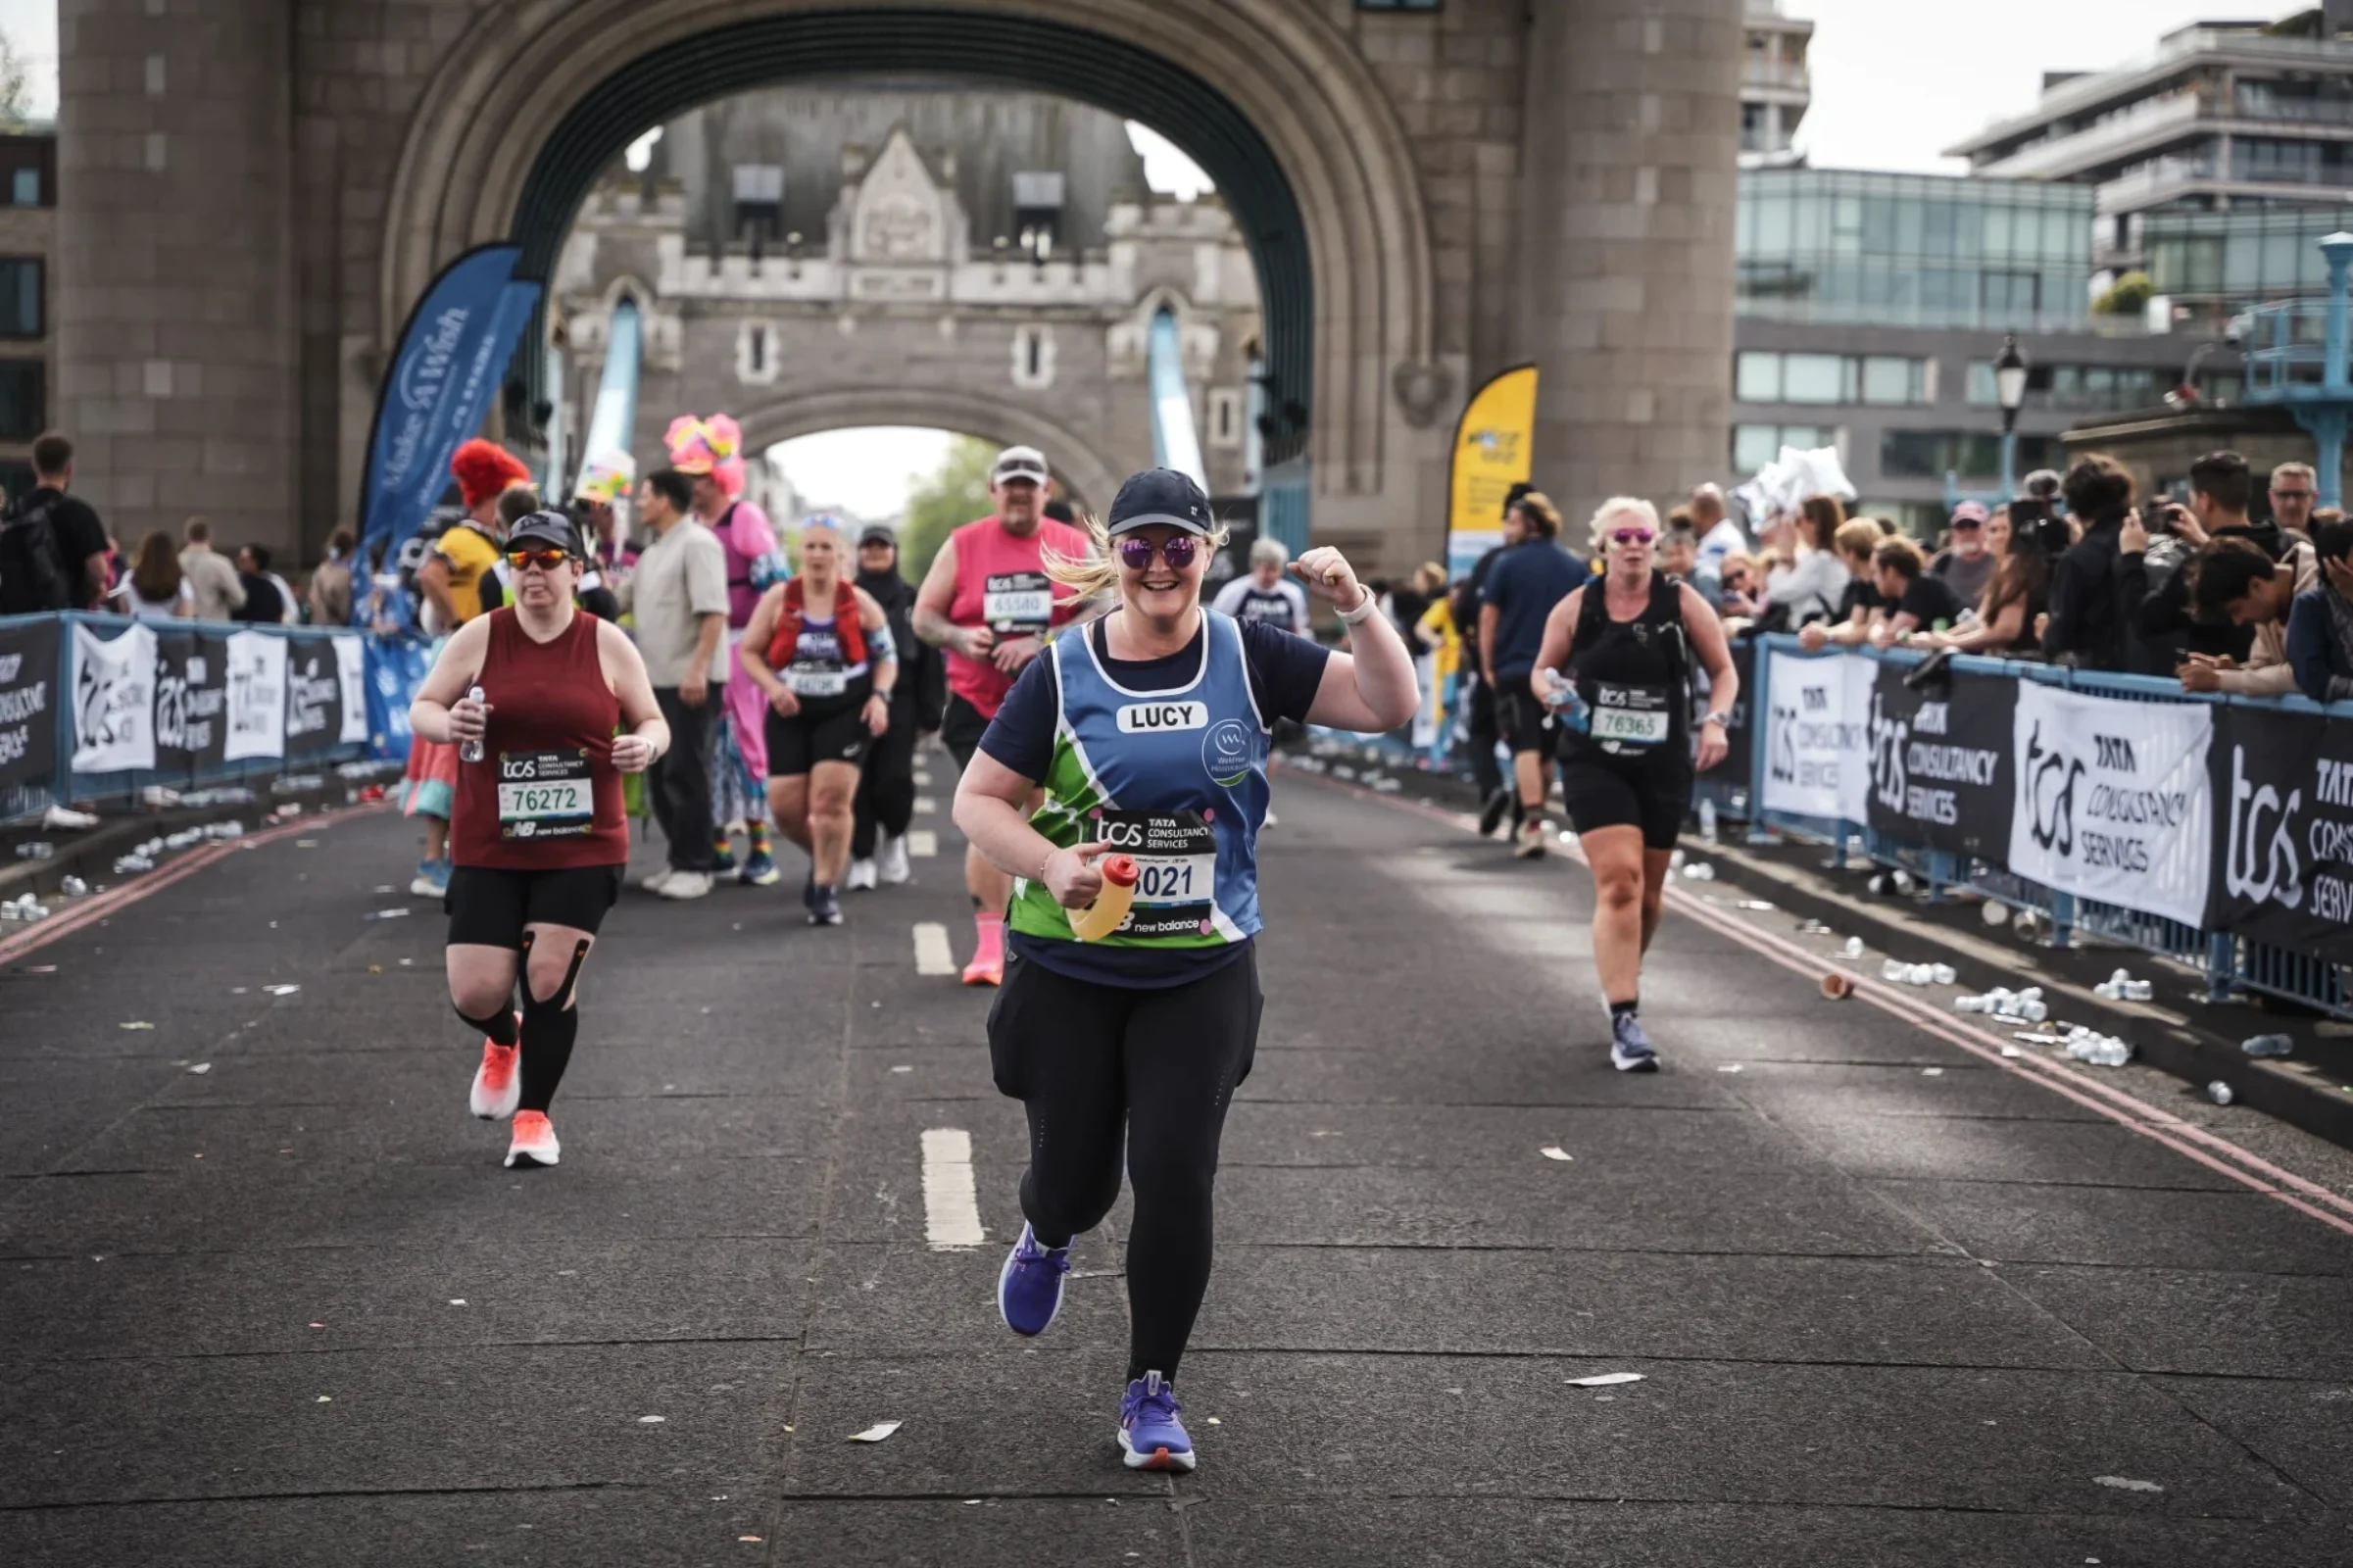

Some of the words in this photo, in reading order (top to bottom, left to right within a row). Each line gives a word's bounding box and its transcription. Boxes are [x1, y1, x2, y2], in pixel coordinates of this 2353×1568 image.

[1131, 706, 1193, 728] LUCY
[1604, 713, 1655, 737] 76365
[1907, 741, 1999, 786] CONSULTANCY
[2093, 733, 2136, 773] TATA
[503, 760, 536, 778] tcs
[513, 787, 576, 811] 76272
[2025, 718, 2085, 858] tcs
[1097, 816, 1142, 847] tcs
[1148, 818, 1176, 827] TATA
[1148, 827, 1208, 838] CONSULTANCY
[2227, 744, 2303, 909] tcs
[1147, 839, 1188, 849] SERVICES
[2081, 830, 2149, 872] SERVICES
[1134, 864, 1193, 897] 021
[1134, 923, 1156, 933] new
[1157, 919, 1200, 932] balance
